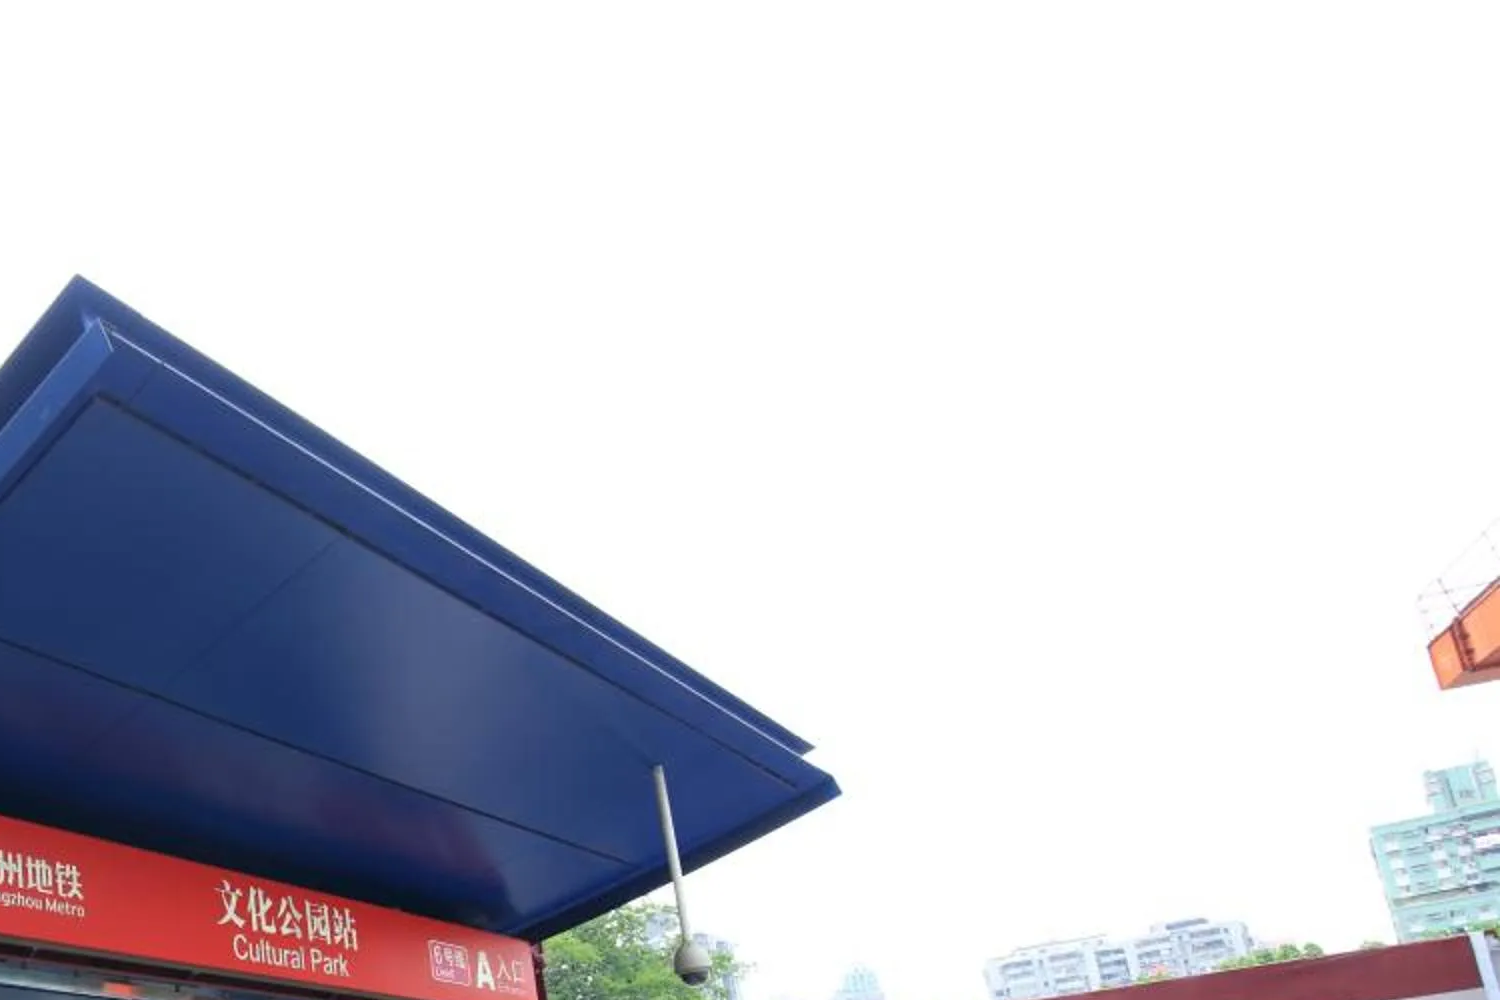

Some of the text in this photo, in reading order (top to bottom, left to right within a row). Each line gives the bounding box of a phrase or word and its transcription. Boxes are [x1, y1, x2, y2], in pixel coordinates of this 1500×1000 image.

[45, 897, 86, 918] Metro
[214, 879, 359, 951] 文化公园站
[232, 933, 351, 978] Cultural Park
[476, 950, 497, 992] A
